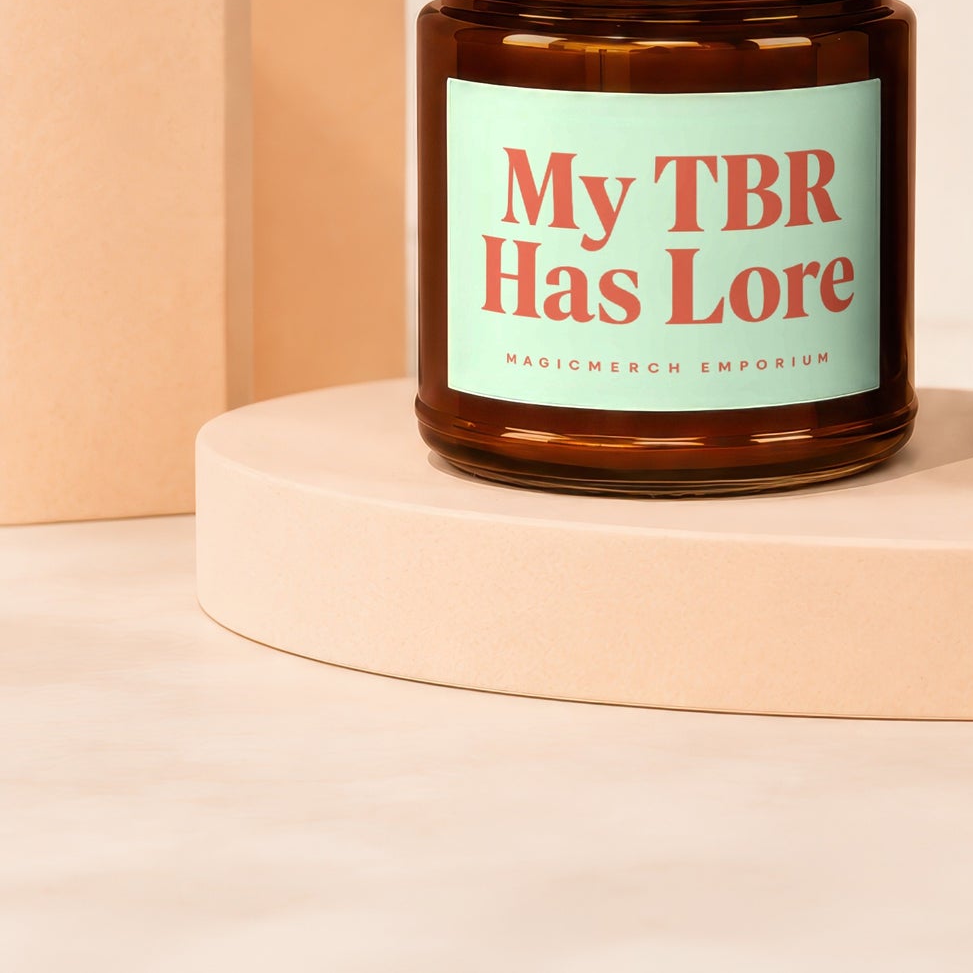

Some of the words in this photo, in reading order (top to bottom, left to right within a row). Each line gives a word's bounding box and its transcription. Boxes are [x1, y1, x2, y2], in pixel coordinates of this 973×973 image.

[501, 146, 635, 253] My
[654, 148, 841, 233] TBR
[481, 234, 641, 325] Has
[665, 248, 855, 326] Lore
[505, 353, 682, 374] MAGICMERCH
[701, 352, 830, 374] EMPORIUM
